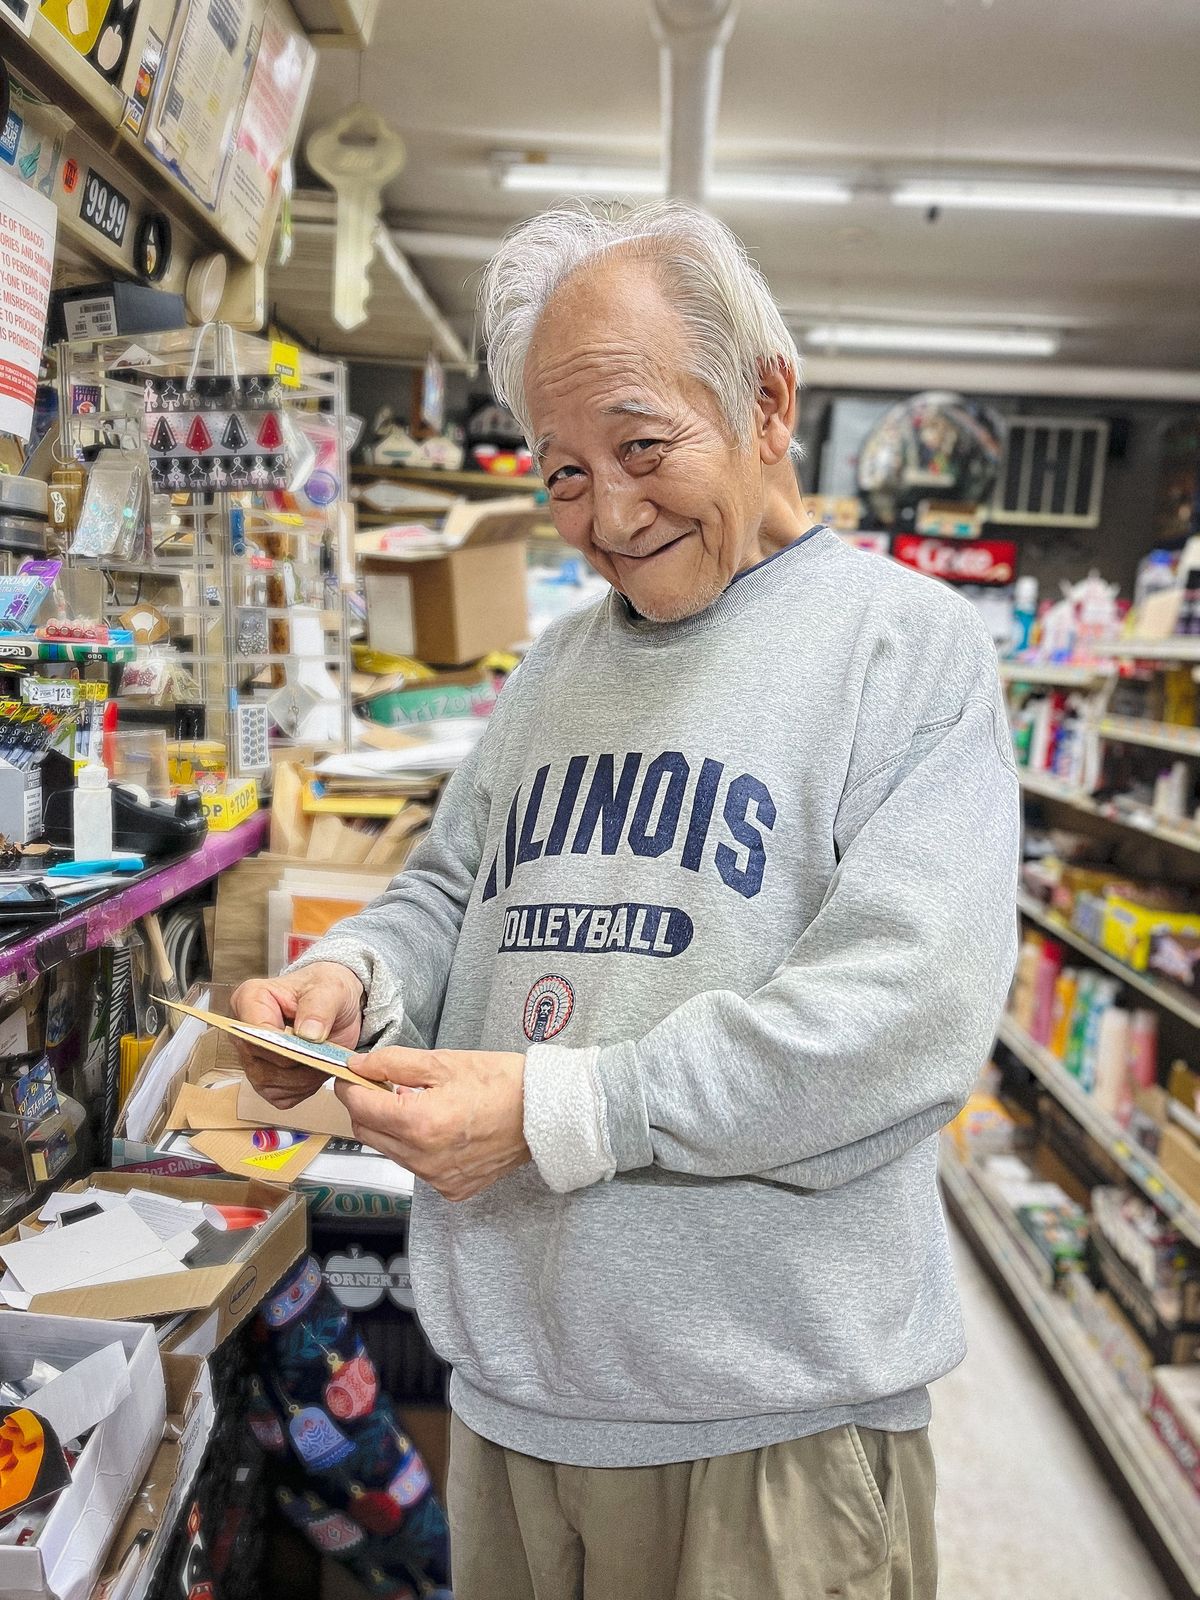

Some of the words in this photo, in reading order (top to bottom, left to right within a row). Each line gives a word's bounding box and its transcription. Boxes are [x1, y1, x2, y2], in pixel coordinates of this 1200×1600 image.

[9, 218, 17, 233] OF
[18, 223, 45, 250] TOBACCO
[21, 243, 33, 261] AND
[1, 252, 10, 268] TO
[12, 257, 38, 283] PERSONS
[5, 310, 13, 324] TO
[14, 314, 37, 339] PROCURE
[32, 686, 39, 701] 2
[201, 804, 223, 817] OP
[27, 1089, 52, 1117] STAPLES
